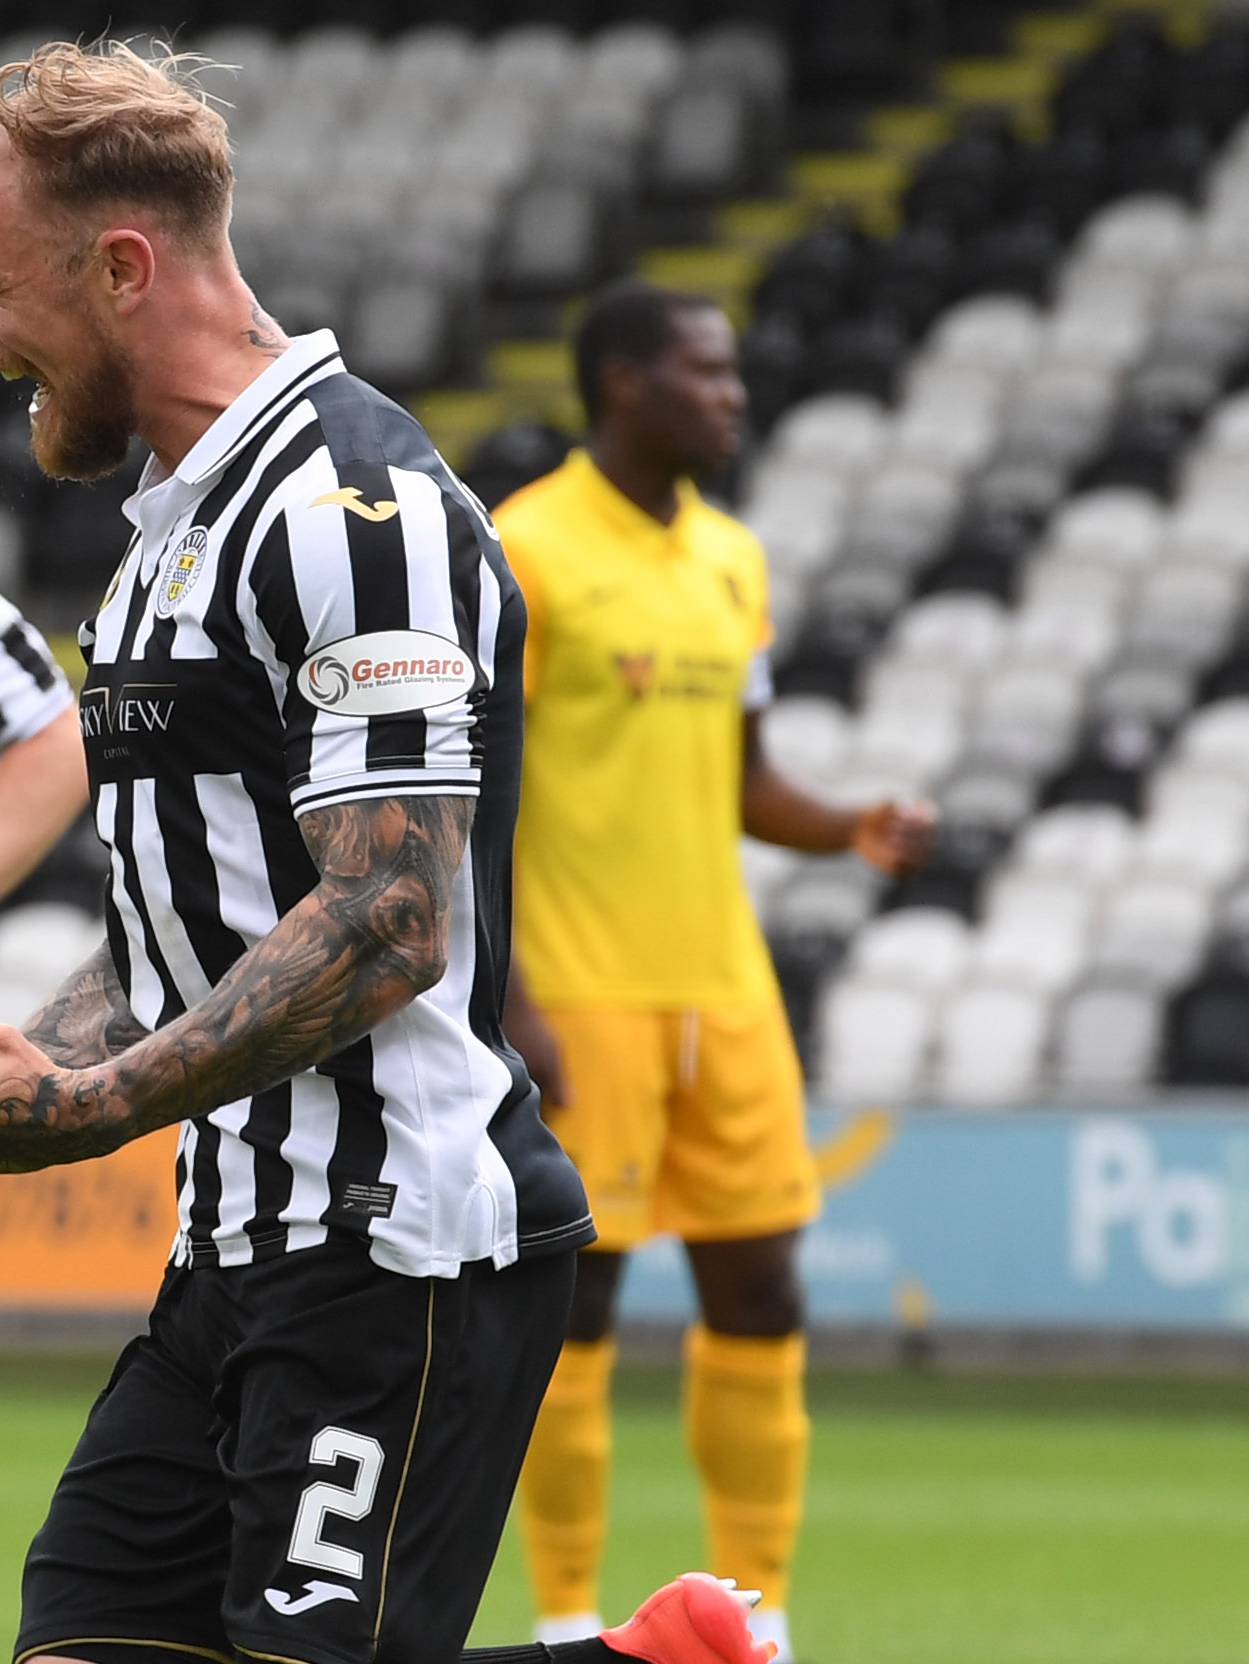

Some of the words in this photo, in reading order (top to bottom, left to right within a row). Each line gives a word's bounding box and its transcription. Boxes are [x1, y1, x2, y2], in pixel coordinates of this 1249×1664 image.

[351, 659, 464, 682] Gennaro
[356, 680, 374, 691] Fire
[376, 677, 402, 687] Rated
[404, 676, 434, 684] Glazing
[287, 1425, 385, 1580] 2
